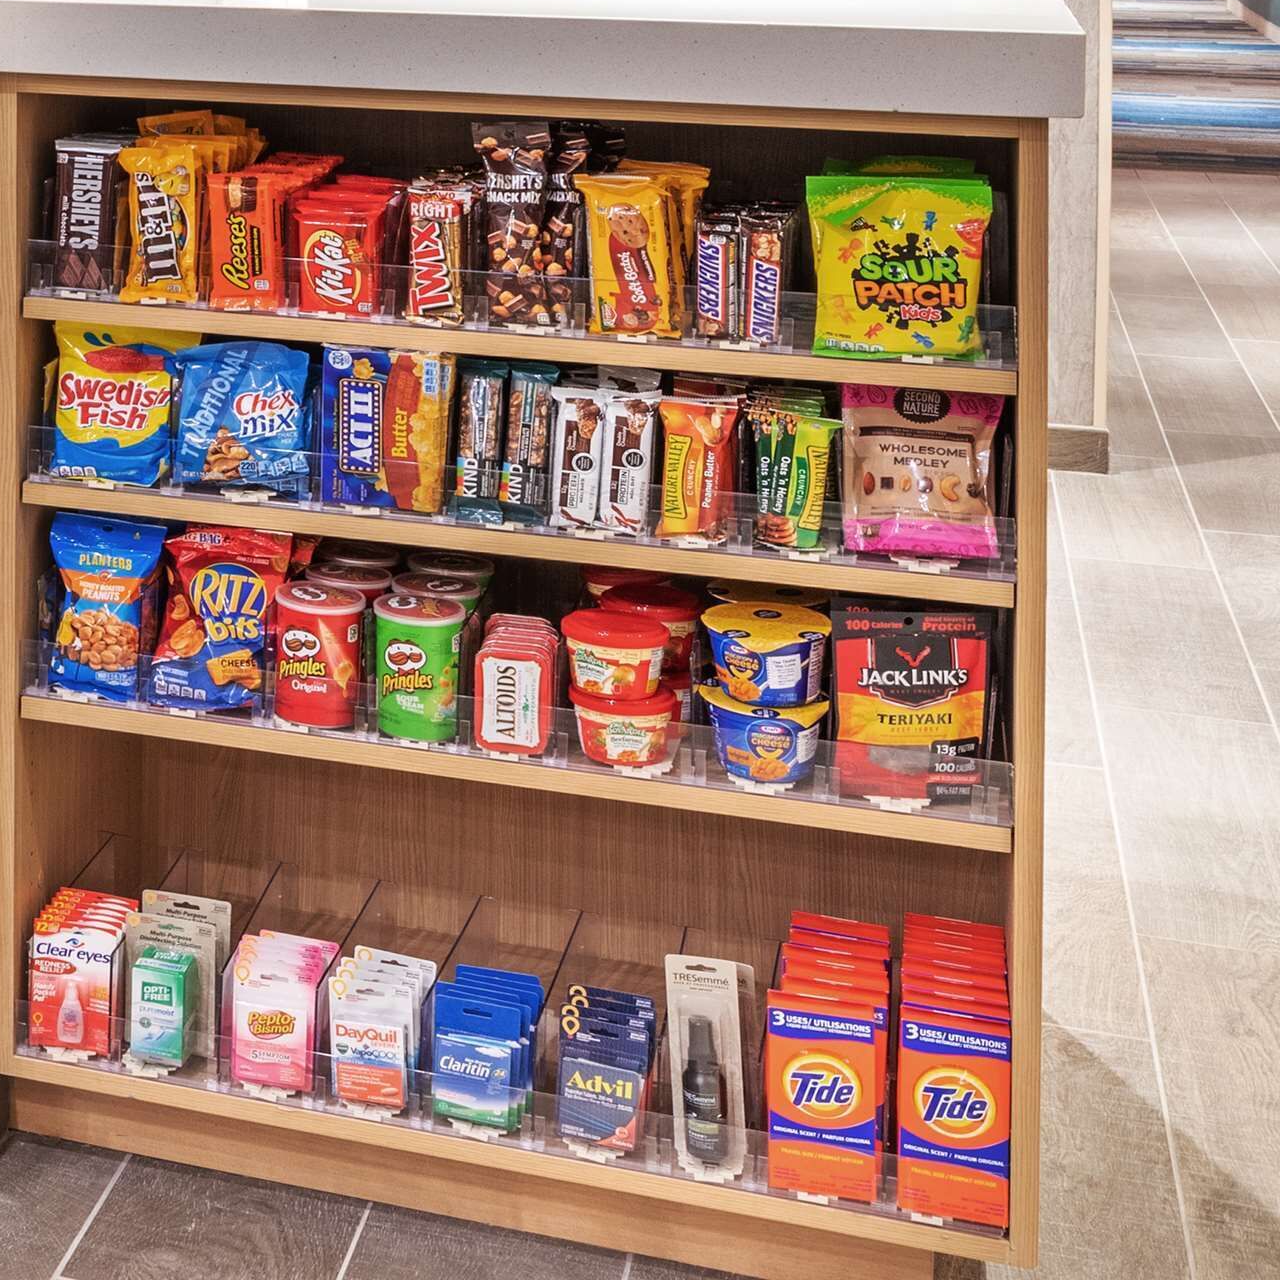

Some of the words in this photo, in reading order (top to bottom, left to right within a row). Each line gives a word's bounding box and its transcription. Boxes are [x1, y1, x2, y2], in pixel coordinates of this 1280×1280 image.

[68, 153, 104, 250] HERSHEY'S
[410, 201, 455, 219] RIGHT
[521, 191, 541, 205] MIX
[410, 222, 454, 317] TWIX
[699, 238, 720, 320] SNICKERS
[859, 253, 959, 283] SOUR
[751, 261, 778, 343] SNICKERS
[854, 280, 966, 308] PATCH
[900, 304, 942, 321] Kids
[59, 372, 171, 408] Swedish
[904, 391, 941, 403] SECOND
[78, 400, 149, 430] Fish
[235, 390, 295, 416] Chex
[349, 390, 373, 418] II
[903, 401, 940, 417] NATURE
[349, 418, 373, 466] ACT
[391, 407, 409, 458] Butter
[668, 435, 687, 475] VALLEY
[879, 443, 967, 458] WHOLESOME
[893, 456, 950, 469] MEDLEY
[241, 461, 256, 470] 220
[704, 450, 716, 479] Butter
[760, 456, 770, 476] Oats
[781, 456, 792, 476] Oats
[813, 447, 829, 485] NATURE
[463, 458, 479, 498] KIND
[507, 463, 523, 505] KIND
[619, 470, 627, 503] PROTEIN
[687, 459, 697, 497] CRUNCHY
[794, 469, 807, 506] CRUNCHY
[664, 474, 683, 516] NATURE
[701, 478, 714, 509] Peanut
[772, 485, 788, 514] Honey
[805, 484, 826, 532] VALLEY
[199, 533, 221, 545] BAG
[79, 552, 133, 571] PLANTERS
[81, 587, 121, 601] PEANUTS
[193, 569, 265, 618] RITZ
[204, 617, 260, 643] bits
[846, 619, 870, 631] 100
[871, 622, 903, 630] Calories
[922, 622, 977, 632] Protein
[220, 659, 256, 669] CHEESE
[279, 658, 327, 680] Pringles
[291, 679, 328, 694] Original
[382, 671, 433, 696] Pringles
[858, 668, 911, 687] JACK
[911, 668, 969, 687] LINK'S
[496, 664, 517, 739] ALTOIDS
[877, 713, 953, 726] TERIYAKI
[935, 744, 957, 757] 13g
[934, 762, 956, 773] 100
[35, 921, 48, 932] 12
[34, 959, 71, 970] REDNESS
[36, 942, 75, 959] Clear
[76, 951, 111, 968] eyes
[143, 985, 171, 995] OPTI-
[673, 972, 730, 987] TRESemmé
[143, 992, 171, 1002] FREE
[248, 1012, 297, 1026] Pepto-
[252, 1022, 295, 1035] Bismol
[772, 1010, 786, 1027] 3
[786, 1015, 811, 1027] USES/
[813, 1018, 872, 1034] UTILISATIONS
[335, 1023, 397, 1043] DayQuil
[905, 1023, 919, 1040] 3
[919, 1028, 946, 1041] USES/
[948, 1032, 1008, 1050] UTILISATIONS
[251, 1049, 258, 1059] 5
[439, 1055, 491, 1078] Claritin
[565, 1070, 633, 1100] Advil
[790, 1071, 855, 1107] Tide
[923, 1084, 989, 1123] Tide
[773, 1125, 799, 1136] ORIGINAL
[799, 1129, 817, 1138] SCENT
[845, 1136, 871, 1145] ORIGINAL
[903, 1143, 930, 1155] ORIGINAL
[930, 1148, 949, 1158] SCENT
[954, 1153, 978, 1163] PARFUM
[978, 1157, 1005, 1168] ORIGINAL
